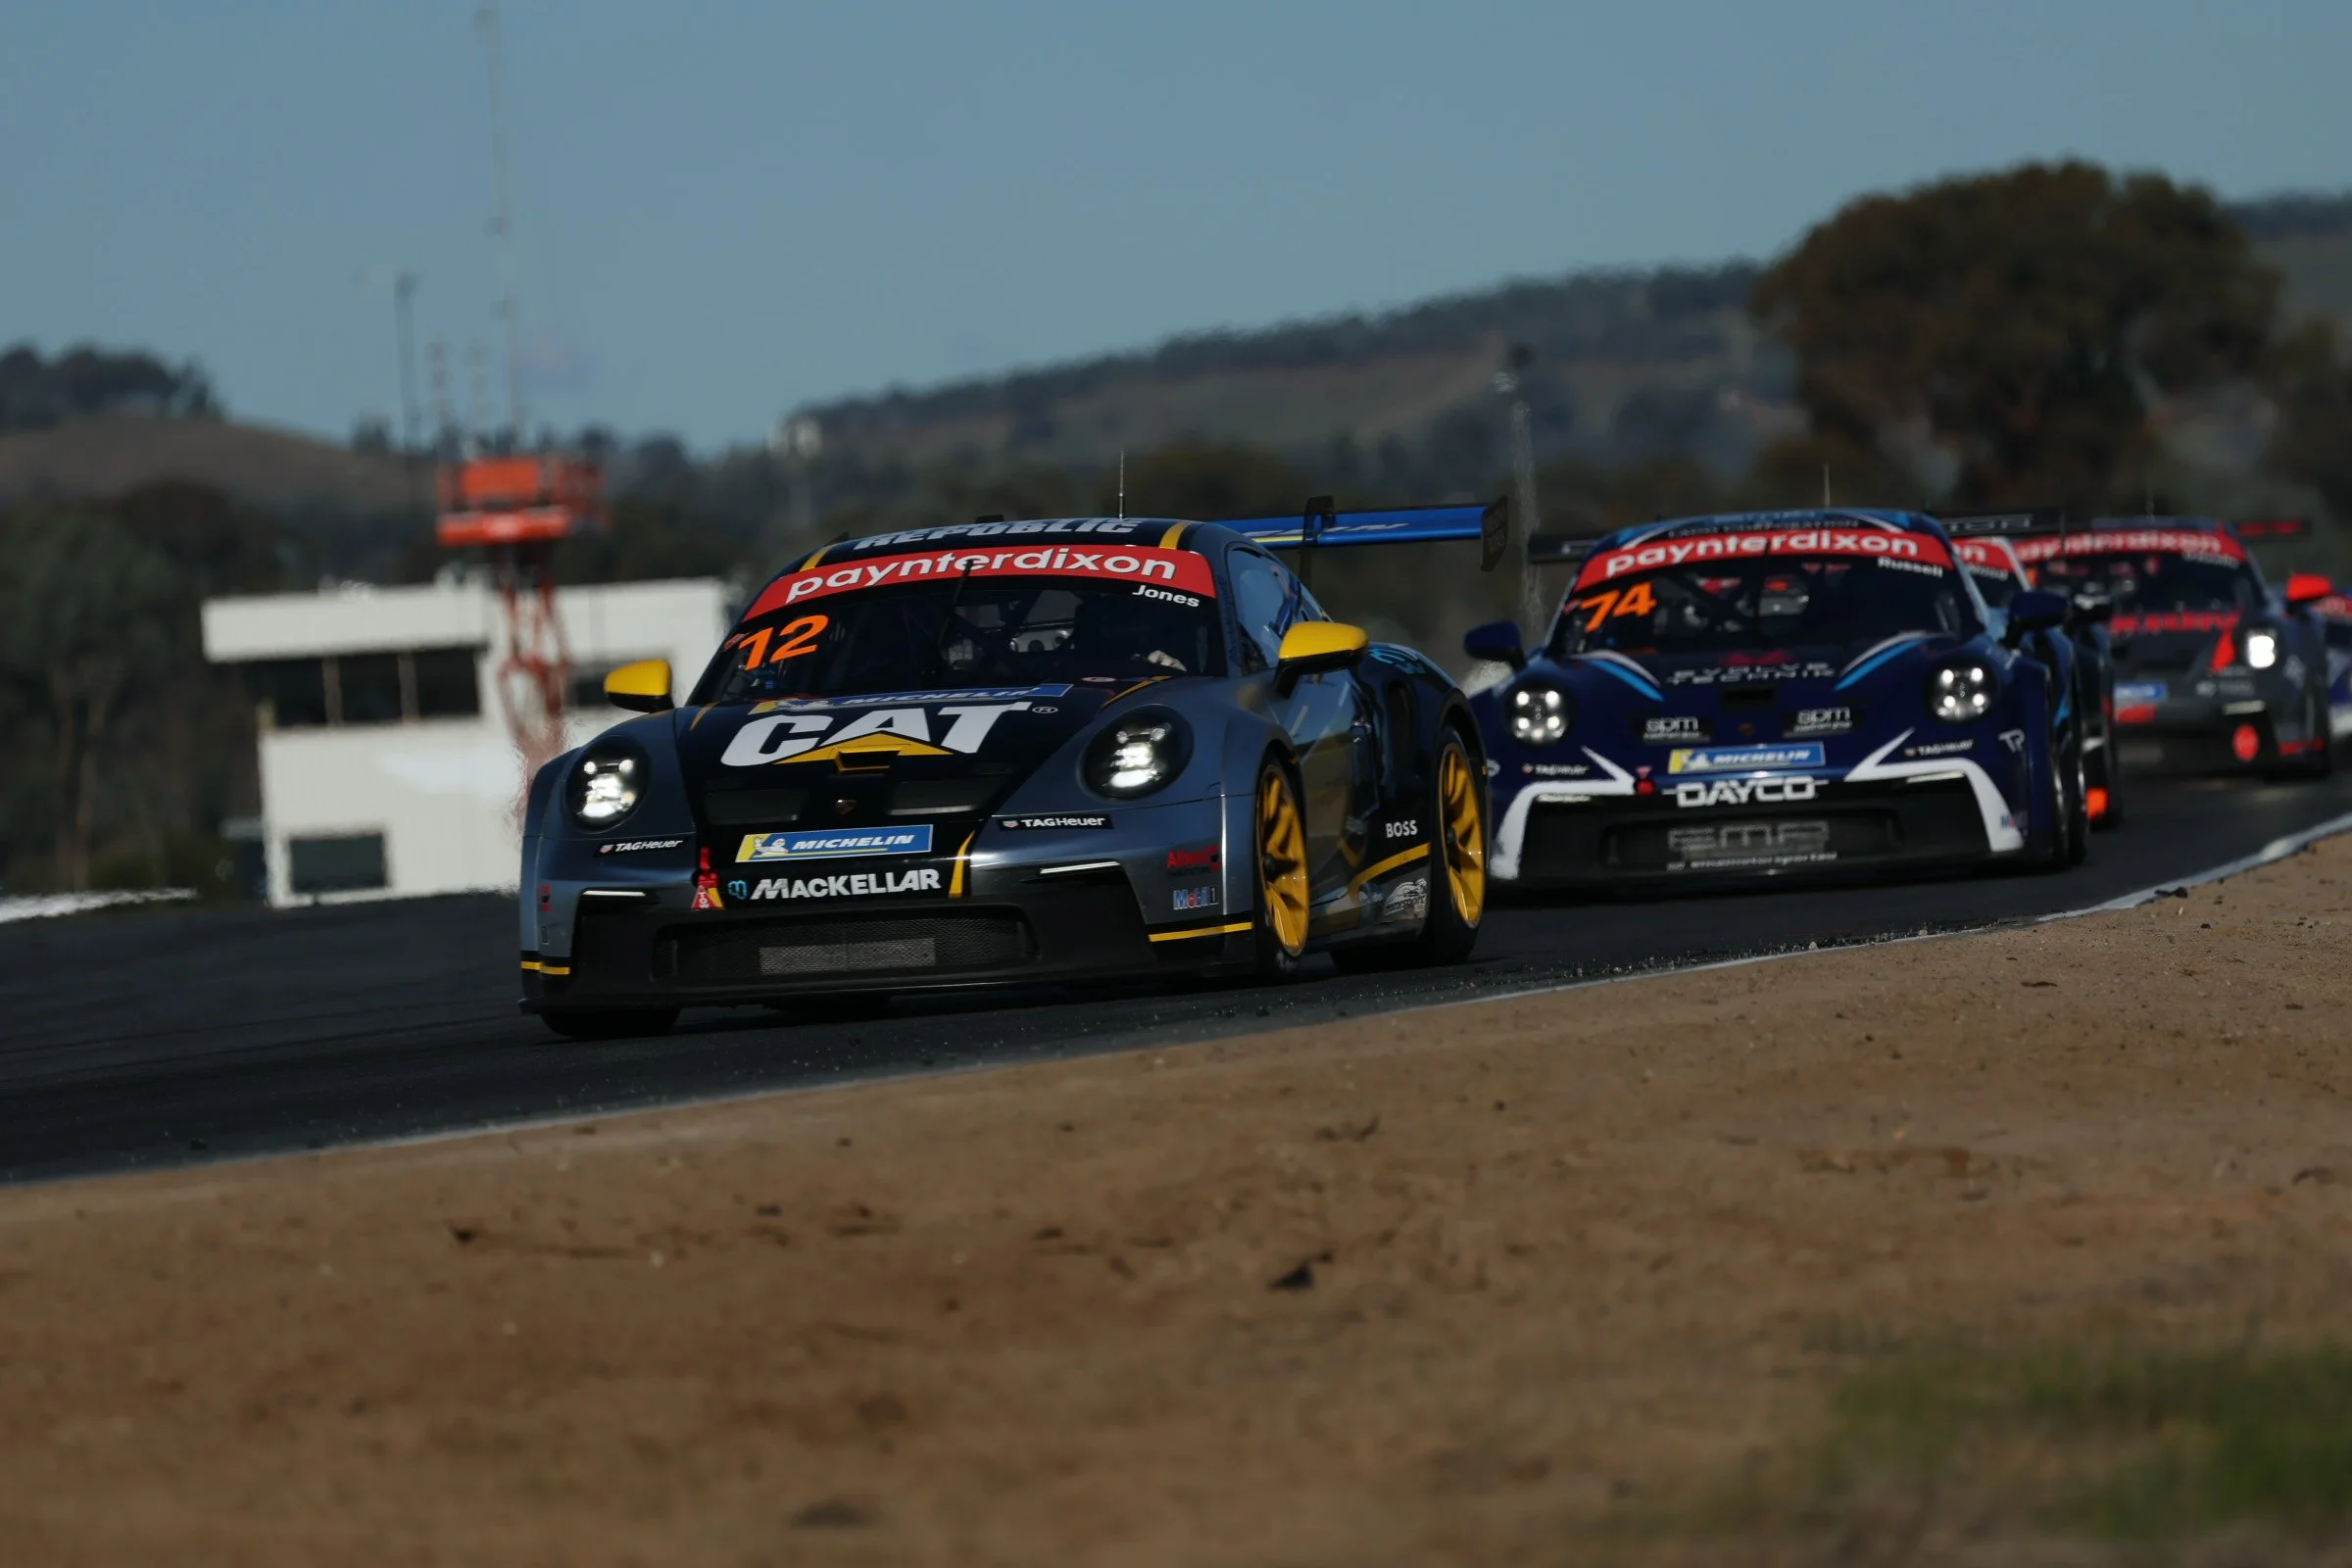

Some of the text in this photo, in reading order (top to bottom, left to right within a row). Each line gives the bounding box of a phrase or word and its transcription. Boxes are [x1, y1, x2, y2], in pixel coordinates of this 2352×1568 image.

[853, 517, 1143, 551] REPUBLIC
[1605, 530, 1919, 579] paynterdixon
[1878, 557, 1943, 578] Russell
[785, 547, 1177, 605] paynterdixon
[1131, 584, 1200, 609] Jones
[1580, 581, 1658, 633] 74
[738, 613, 830, 671] 12
[842, 687, 1041, 706] MICHELIN
[720, 701, 1033, 767] CAT
[1713, 749, 1811, 765] MICHELIN
[1676, 775, 1816, 808] DAYCO
[791, 834, 915, 851] MICHELIN
[1385, 819, 1418, 839] BOSS
[750, 868, 942, 901] MACKELLAR
